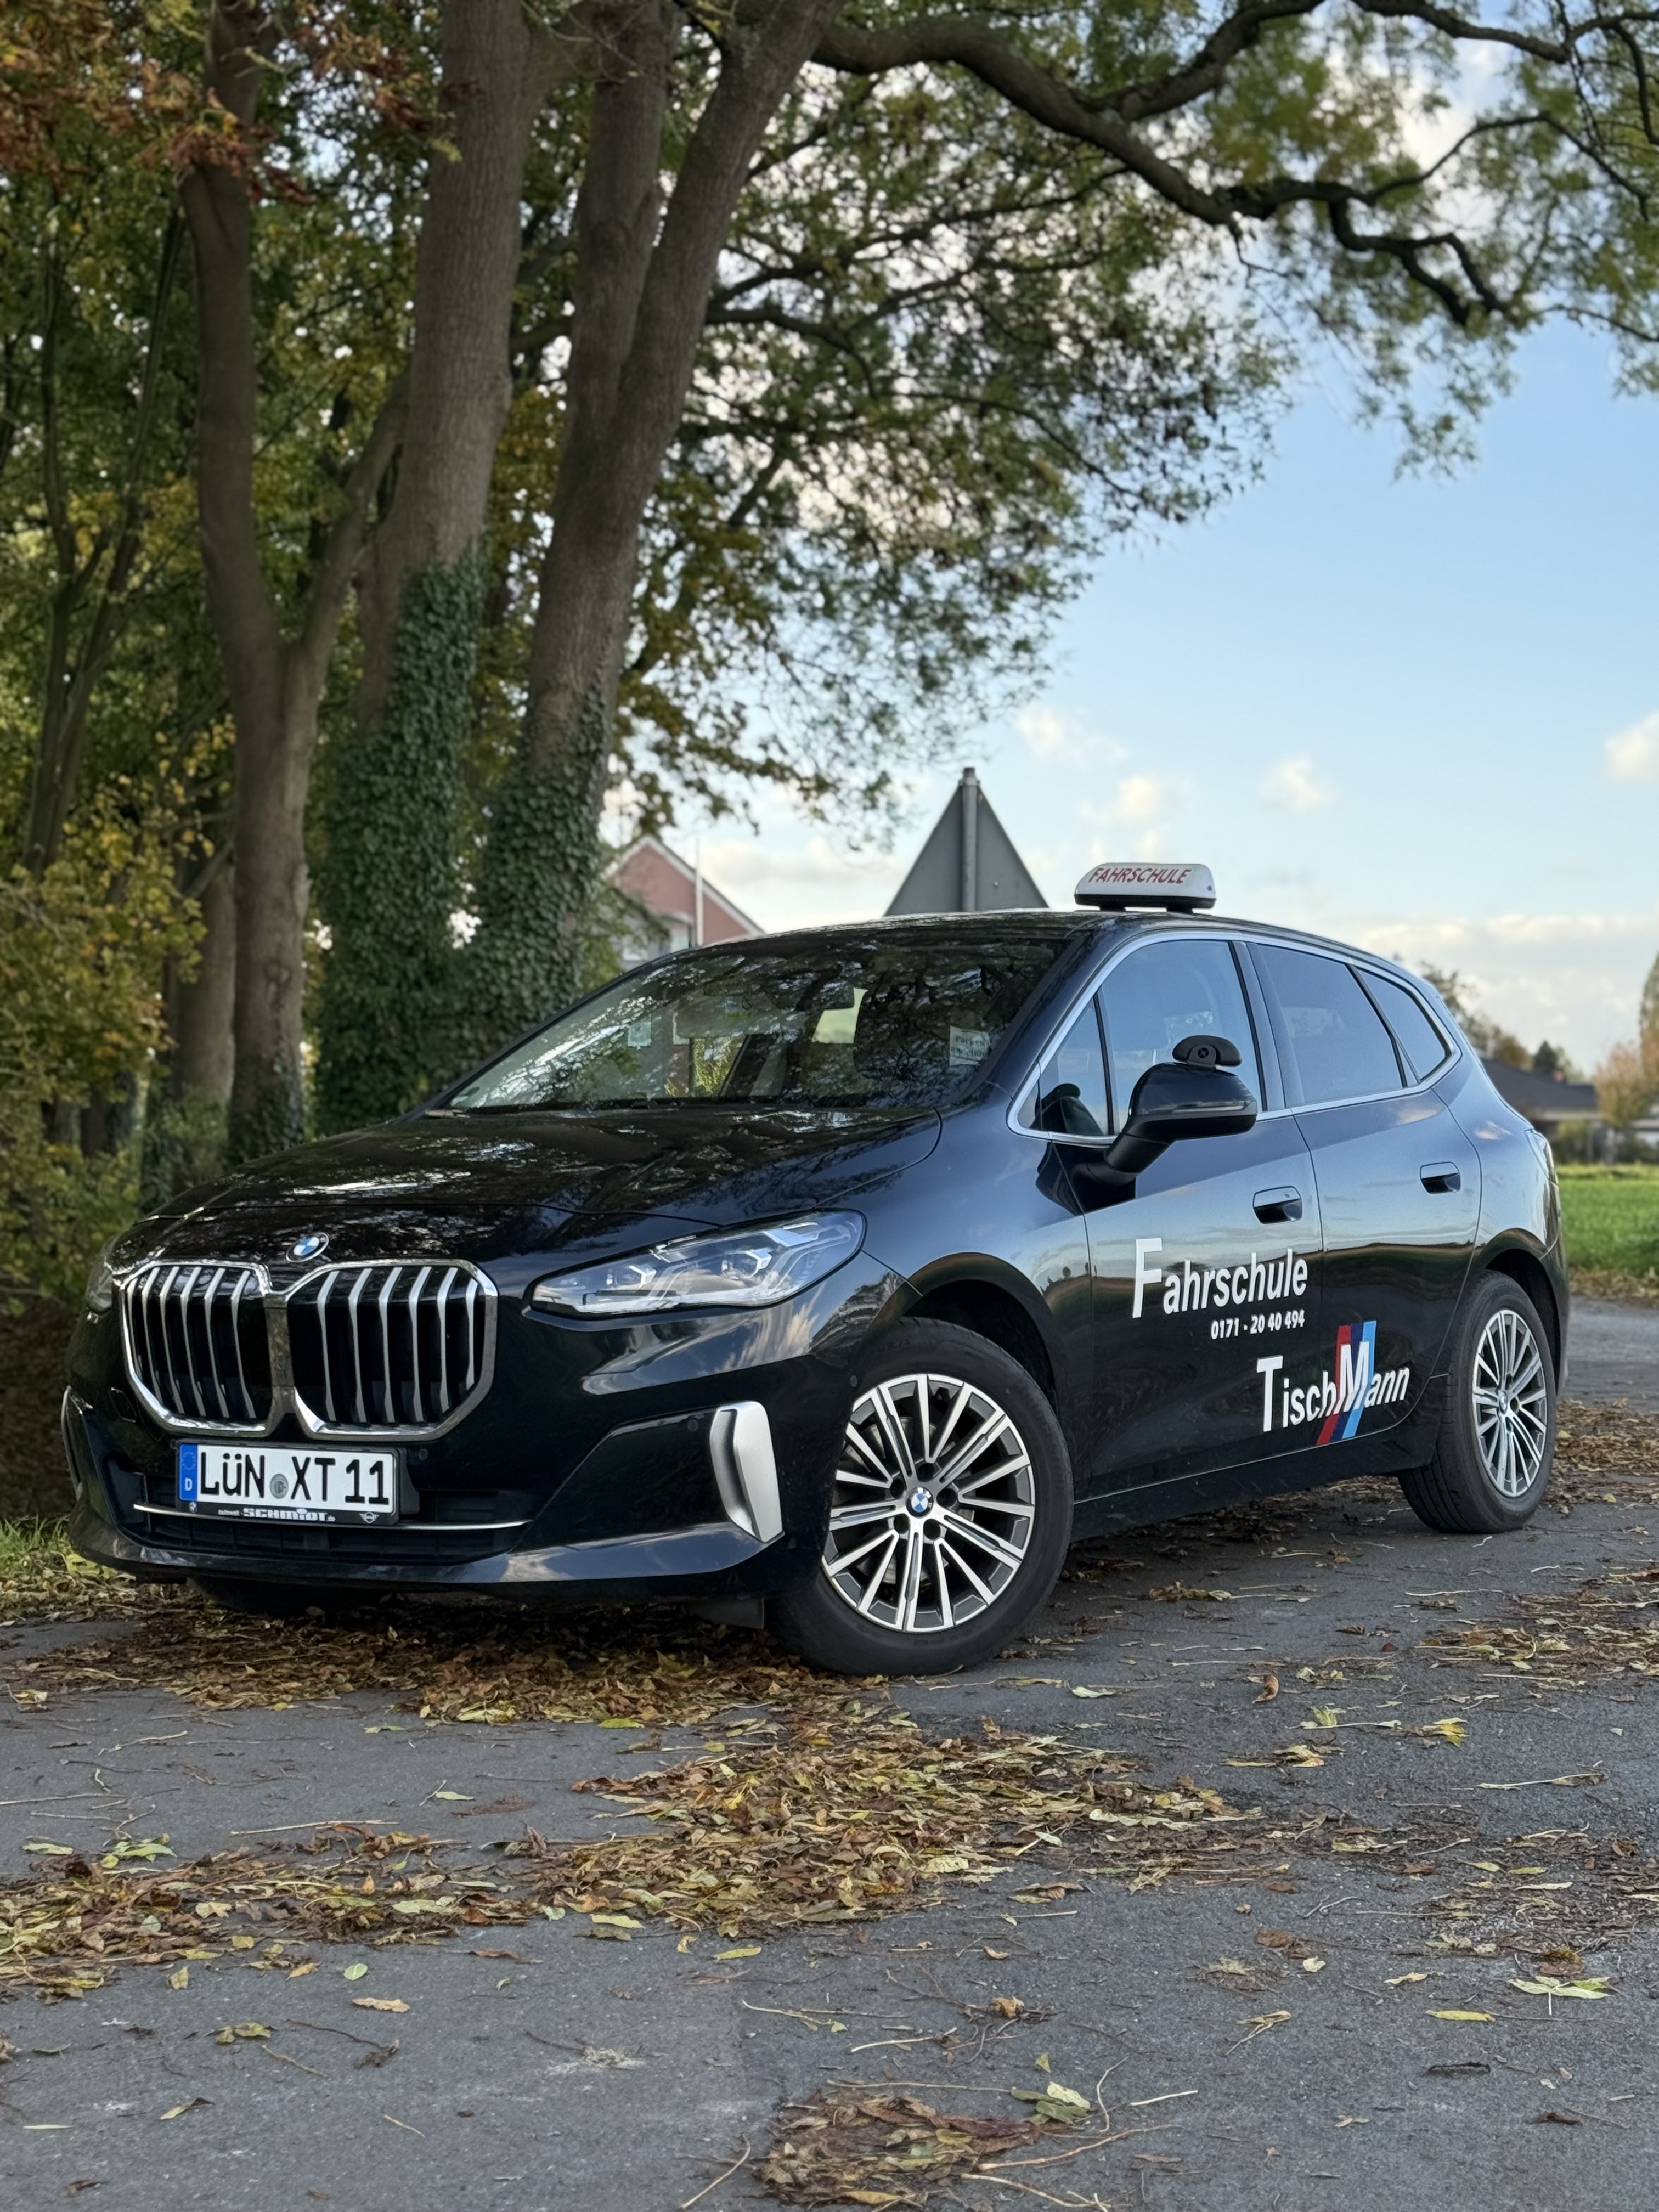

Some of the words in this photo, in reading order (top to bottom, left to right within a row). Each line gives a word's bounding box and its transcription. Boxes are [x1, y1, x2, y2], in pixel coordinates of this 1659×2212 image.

[1088, 868, 1192, 884] FAHRSCHULE
[1132, 1238, 1308, 1318] Fahrschule
[1211, 1318, 1239, 1340] 0171
[1250, 1314, 1265, 1334] 20
[1267, 1312, 1282, 1331] 40
[1284, 1308, 1305, 1329] 494
[1256, 1341, 1410, 1432] TischMann
[184, 1477, 193, 1491] D
[200, 1452, 265, 1499] LÜN
[290, 1456, 336, 1502] XT
[345, 1459, 390, 1505] 11
